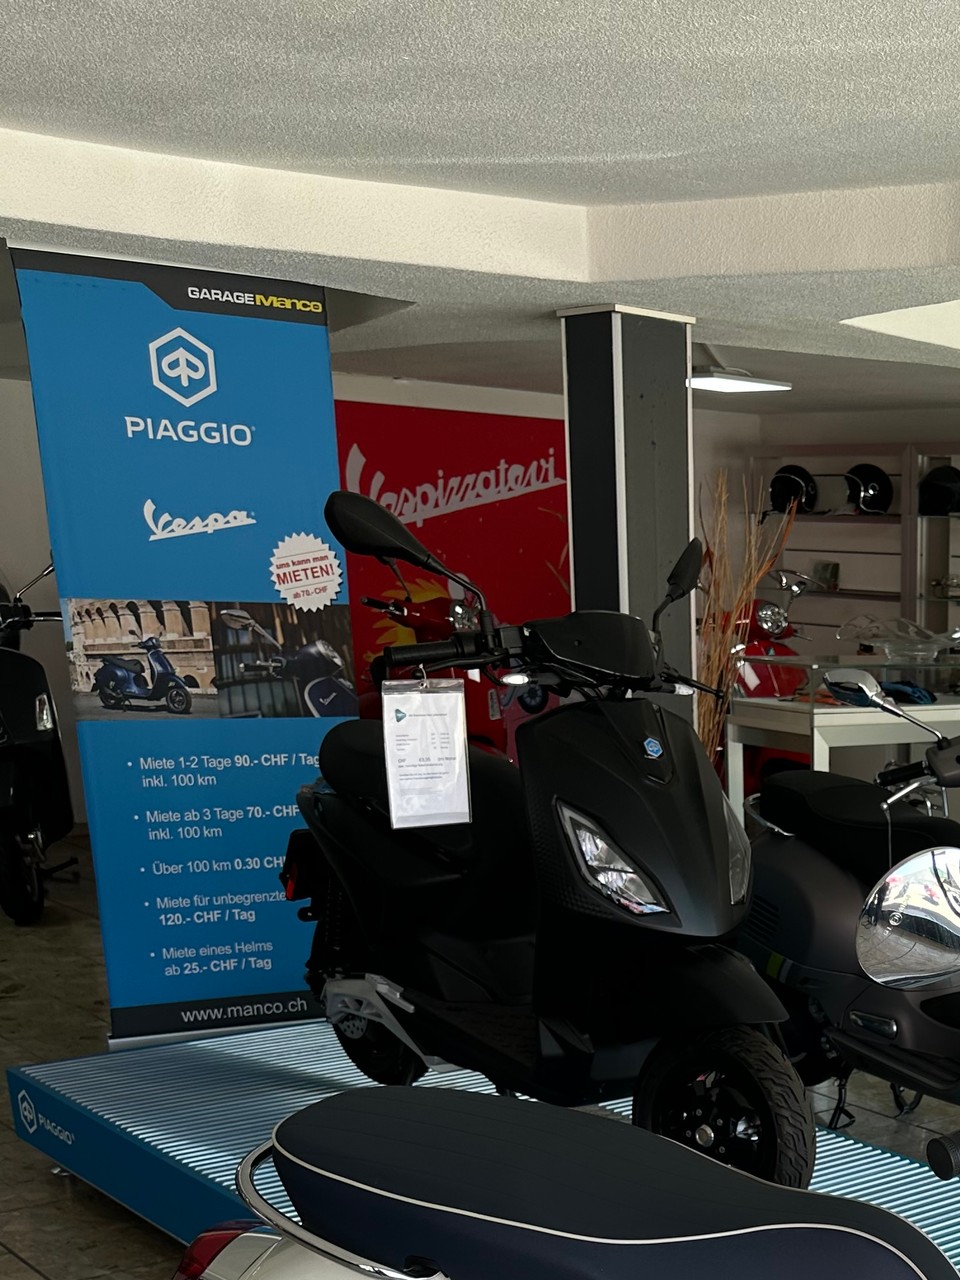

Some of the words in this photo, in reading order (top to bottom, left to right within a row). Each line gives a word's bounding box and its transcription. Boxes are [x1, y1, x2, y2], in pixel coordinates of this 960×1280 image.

[124, 416, 252, 446] PIAGGIO
[143, 498, 257, 541] Vespa
[276, 562, 290, 570] uns
[292, 558, 311, 566] kann
[276, 563, 335, 586] MIETEN!
[140, 757, 175, 770] Miete
[178, 756, 198, 769] 1-2
[201, 755, 232, 771] Tage
[234, 755, 259, 767] 90.-
[261, 753, 289, 767] CHF
[142, 775, 168, 788] inkl.
[171, 774, 195, 787] 100
[197, 774, 217, 786] km
[146, 810, 181, 823] Miete
[184, 809, 200, 822] ab
[203, 808, 212, 820] 3
[214, 807, 244, 823] Tage
[246, 806, 271, 819] 70.-
[273, 805, 300, 818] CHF
[148, 828, 174, 841] inkl.
[177, 826, 200, 839] 100
[203, 826, 223, 838] km
[152, 861, 183, 875] Über
[187, 860, 210, 873] 100
[212, 860, 232, 871] km
[234, 858, 261, 870] 0.30
[263, 856, 287, 869] CH
[156, 897, 191, 909] Miete
[194, 894, 210, 907] für
[159, 913, 191, 926] 120.-
[193, 910, 222, 924] CHF
[232, 908, 256, 923] Tag
[162, 947, 197, 960] Miete
[199, 944, 233, 957] eines
[234, 941, 274, 954] Helms
[164, 964, 181, 977] ab
[183, 962, 208, 975] 25.-
[210, 958, 239, 972] CHF
[248, 957, 272, 971] Tag
[181, 997, 308, 1023] www.manco.ch
[38, 1113, 73, 1145] PIAGGIO
